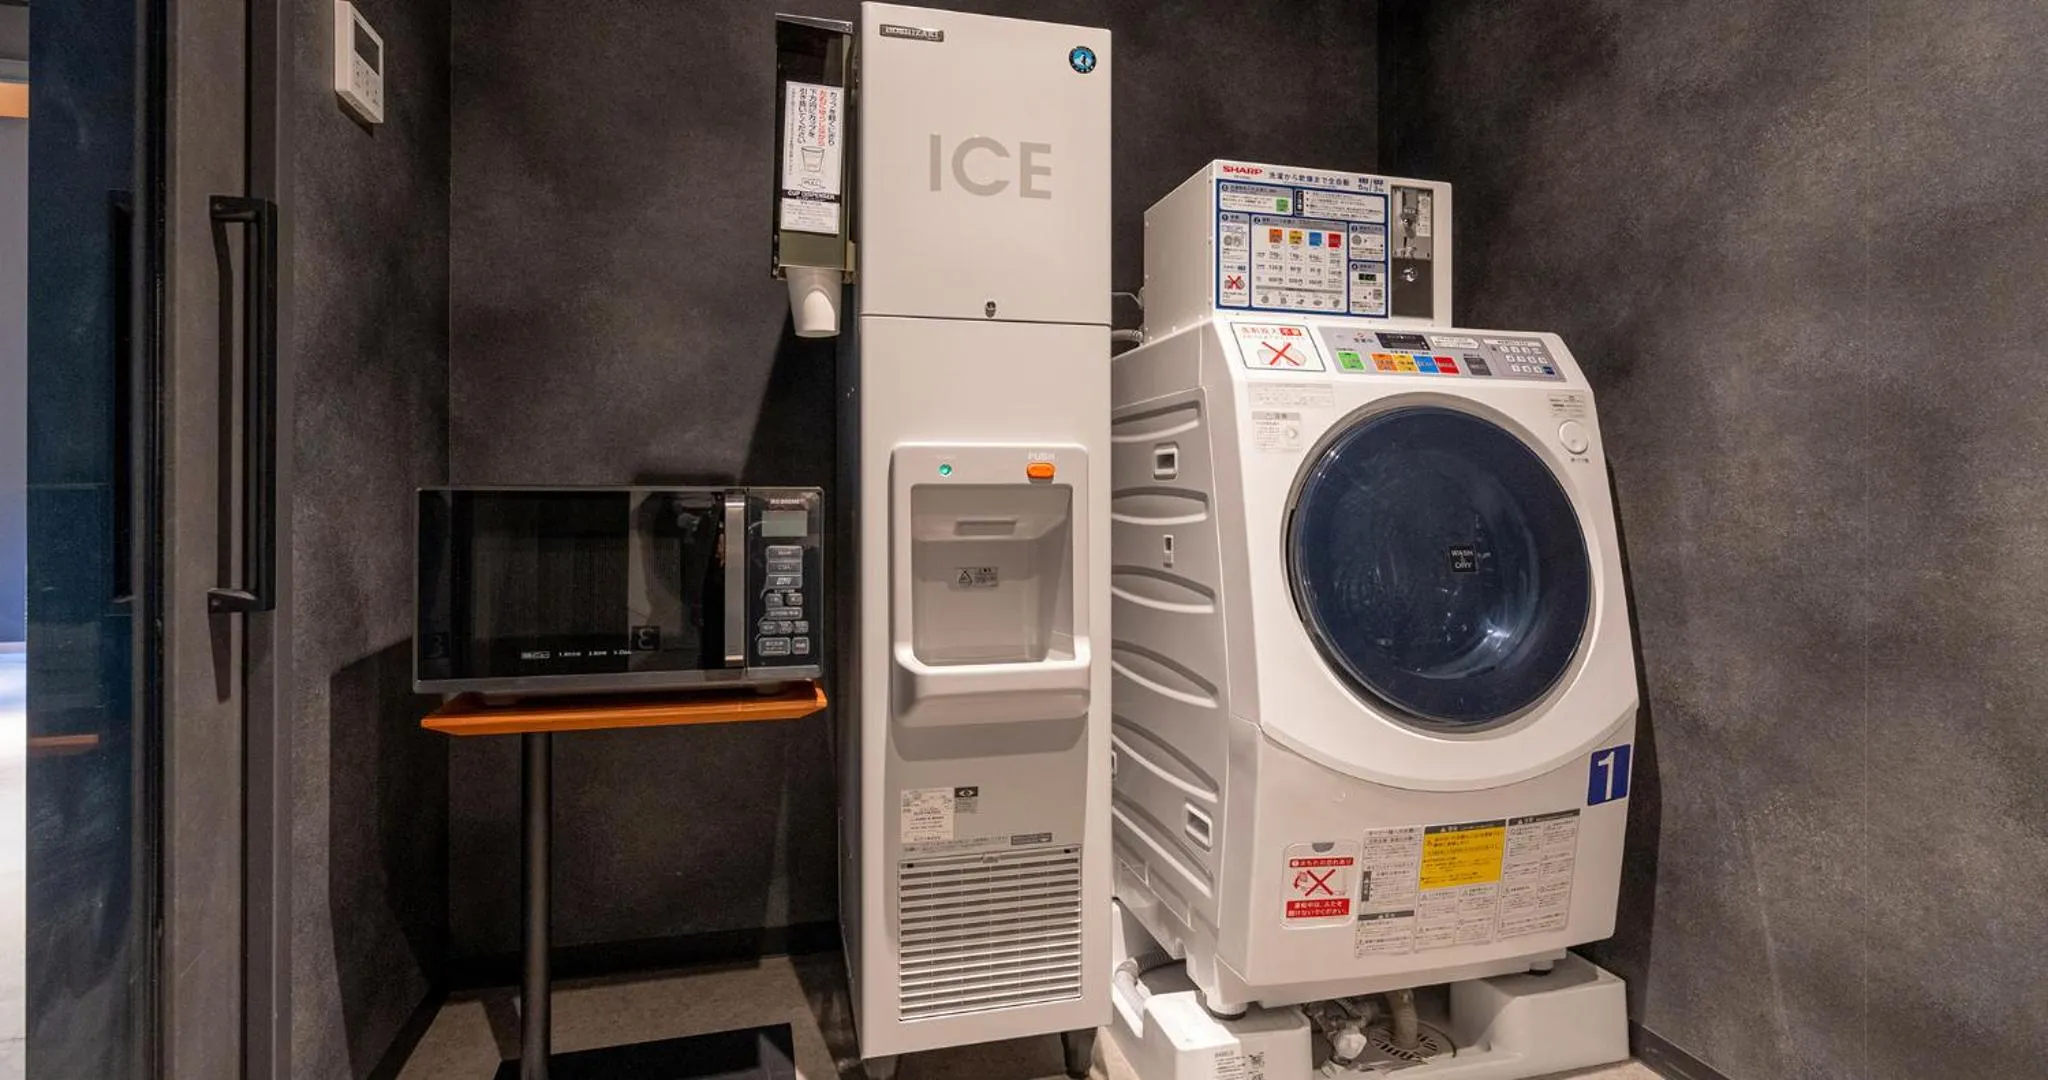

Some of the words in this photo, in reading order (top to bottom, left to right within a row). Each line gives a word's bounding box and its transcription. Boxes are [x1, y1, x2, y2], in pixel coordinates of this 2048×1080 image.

[930, 133, 1052, 200] ICE
[1223, 165, 1263, 176] SHARP
[1268, 171, 1350, 186] 洗濯から乾燥まで全自動
[1451, 549, 1474, 557] WASH
[1598, 751, 1615, 801] 1
